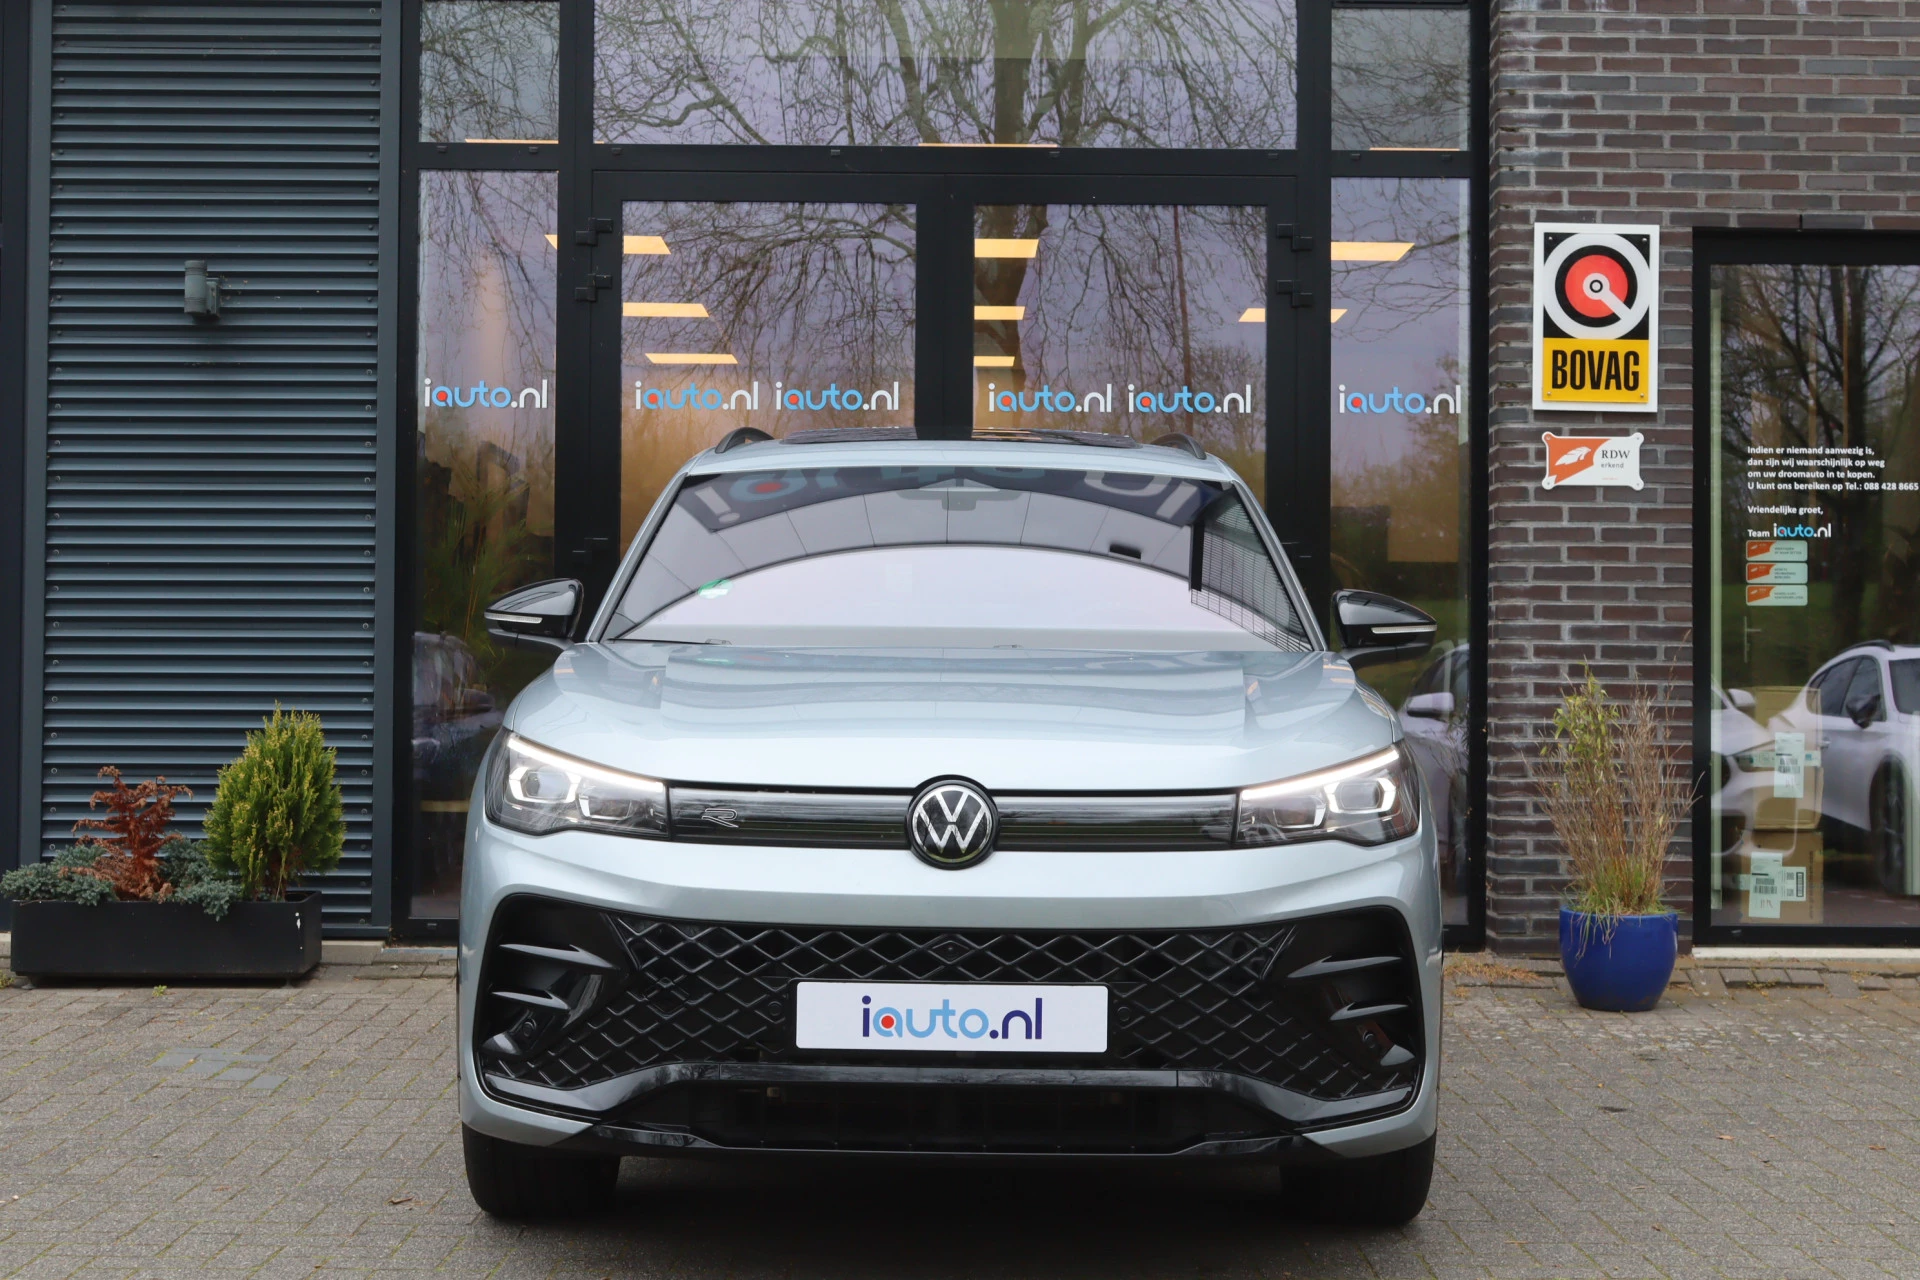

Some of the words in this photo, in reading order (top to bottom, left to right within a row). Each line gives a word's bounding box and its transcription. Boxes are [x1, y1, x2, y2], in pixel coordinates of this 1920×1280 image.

[1551, 349, 1640, 392] BOVAG
[424, 377, 548, 409] iauto.nl
[634, 380, 759, 411] iauto.nl
[775, 381, 899, 411] iauto.nl
[987, 382, 1112, 413] iauto.nl
[1127, 383, 1252, 414] iauto.nl
[1338, 384, 1463, 415] iauto.nl
[1601, 449, 1631, 459] RDW
[1747, 446, 1774, 455] Indien
[1775, 447, 1785, 455] er
[1786, 446, 1824, 455] niemand
[1824, 446, 1864, 457] aanwezig
[1865, 446, 1875, 456] is,
[1600, 461, 1625, 469] erkend
[1747, 457, 1764, 466] dan
[1765, 457, 1780, 468] zijn
[1781, 457, 1795, 468] wij
[1796, 457, 1853, 468] waarschijnlijk
[1854, 459, 1866, 468] op
[1867, 459, 1886, 469] weg
[1747, 470, 1762, 478] om
[1778, 469, 1825, 478] droomauto
[1826, 469, 1835, 478] in
[1836, 470, 1846, 478] te
[1847, 469, 1876, 480] kopen.
[1747, 481, 1755, 490] U
[1756, 481, 1776, 490] kunt
[1793, 481, 1831, 490] bereiken
[1831, 483, 1844, 492] op
[1844, 481, 1863, 490] Tel.:
[1863, 482, 1880, 491] 088
[1881, 482, 1897, 491] 428
[1898, 482, 1920, 491] 8665
[1747, 505, 1798, 516] Vriendelijke
[1798, 506, 1824, 516] groet,
[1747, 529, 1771, 539] Team
[1773, 523, 1832, 539] iauto.nl
[861, 994, 1043, 1040] iauto.nl
